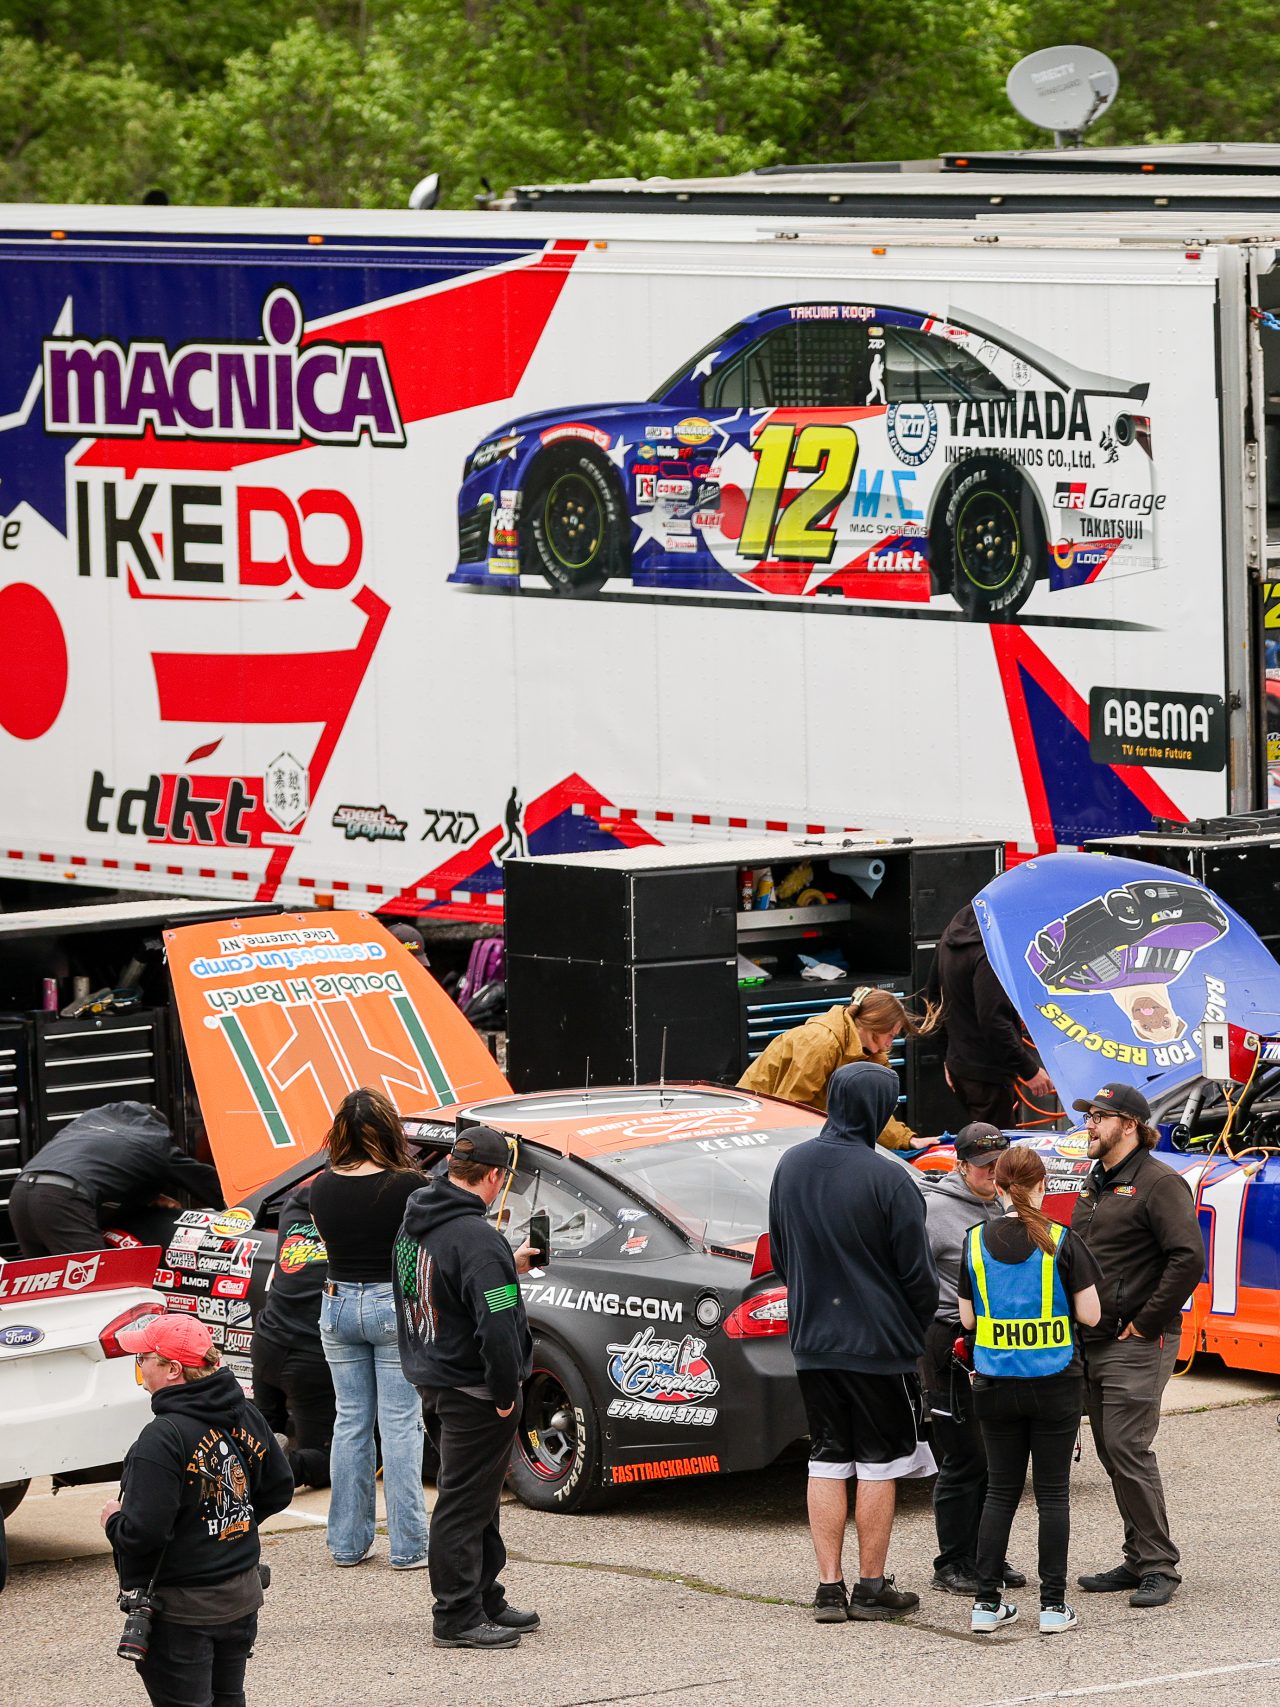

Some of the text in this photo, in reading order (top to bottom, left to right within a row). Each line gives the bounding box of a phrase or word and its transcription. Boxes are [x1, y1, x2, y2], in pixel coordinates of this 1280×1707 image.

[789, 307, 838, 319] TAKUMA
[46, 288, 402, 442] MACNICA
[946, 391, 1093, 441] YAMADA
[737, 423, 859, 562] 12
[1090, 488, 1167, 516] Garage
[75, 480, 363, 589] IKEDO
[850, 524, 928, 536] MAC SYSTEMS
[1080, 518, 1143, 539] TAKATSUJI
[867, 551, 924, 572] tdkt
[1104, 699, 1211, 743] ABEMA
[1121, 744, 1193, 760] TV for the Future
[86, 770, 257, 846] tdkt
[222, 938, 243, 953] NY
[302, 929, 337, 942] Lake
[192, 959, 251, 977] camp
[207, 973, 404, 1011] Double H Ranch
[1039, 1002, 1149, 1067] RESCUES
[1152, 1039, 1197, 1067] FOR
[696, 1133, 770, 1152] KEMP
[1055, 1139, 1088, 1148] MENA
[166, 1250, 195, 1261] QUARTER
[170, 1259, 195, 1268] MASTER
[198, 1257, 231, 1272] COMETIC
[287, 1251, 328, 1268] TRAC
[11, 1269, 65, 1296] TIRE
[154, 1270, 173, 1284] RP
[182, 1275, 210, 1288] ILMOR
[518, 1283, 684, 1323] ETAILING.COM
[5, 1329, 34, 1344] Ford
[992, 1320, 1065, 1347] PHOTO
[620, 1360, 720, 1396] Graphics
[607, 1399, 717, 1426] 574-400-9799
[611, 1455, 720, 1484] FASTTRACKRACING
